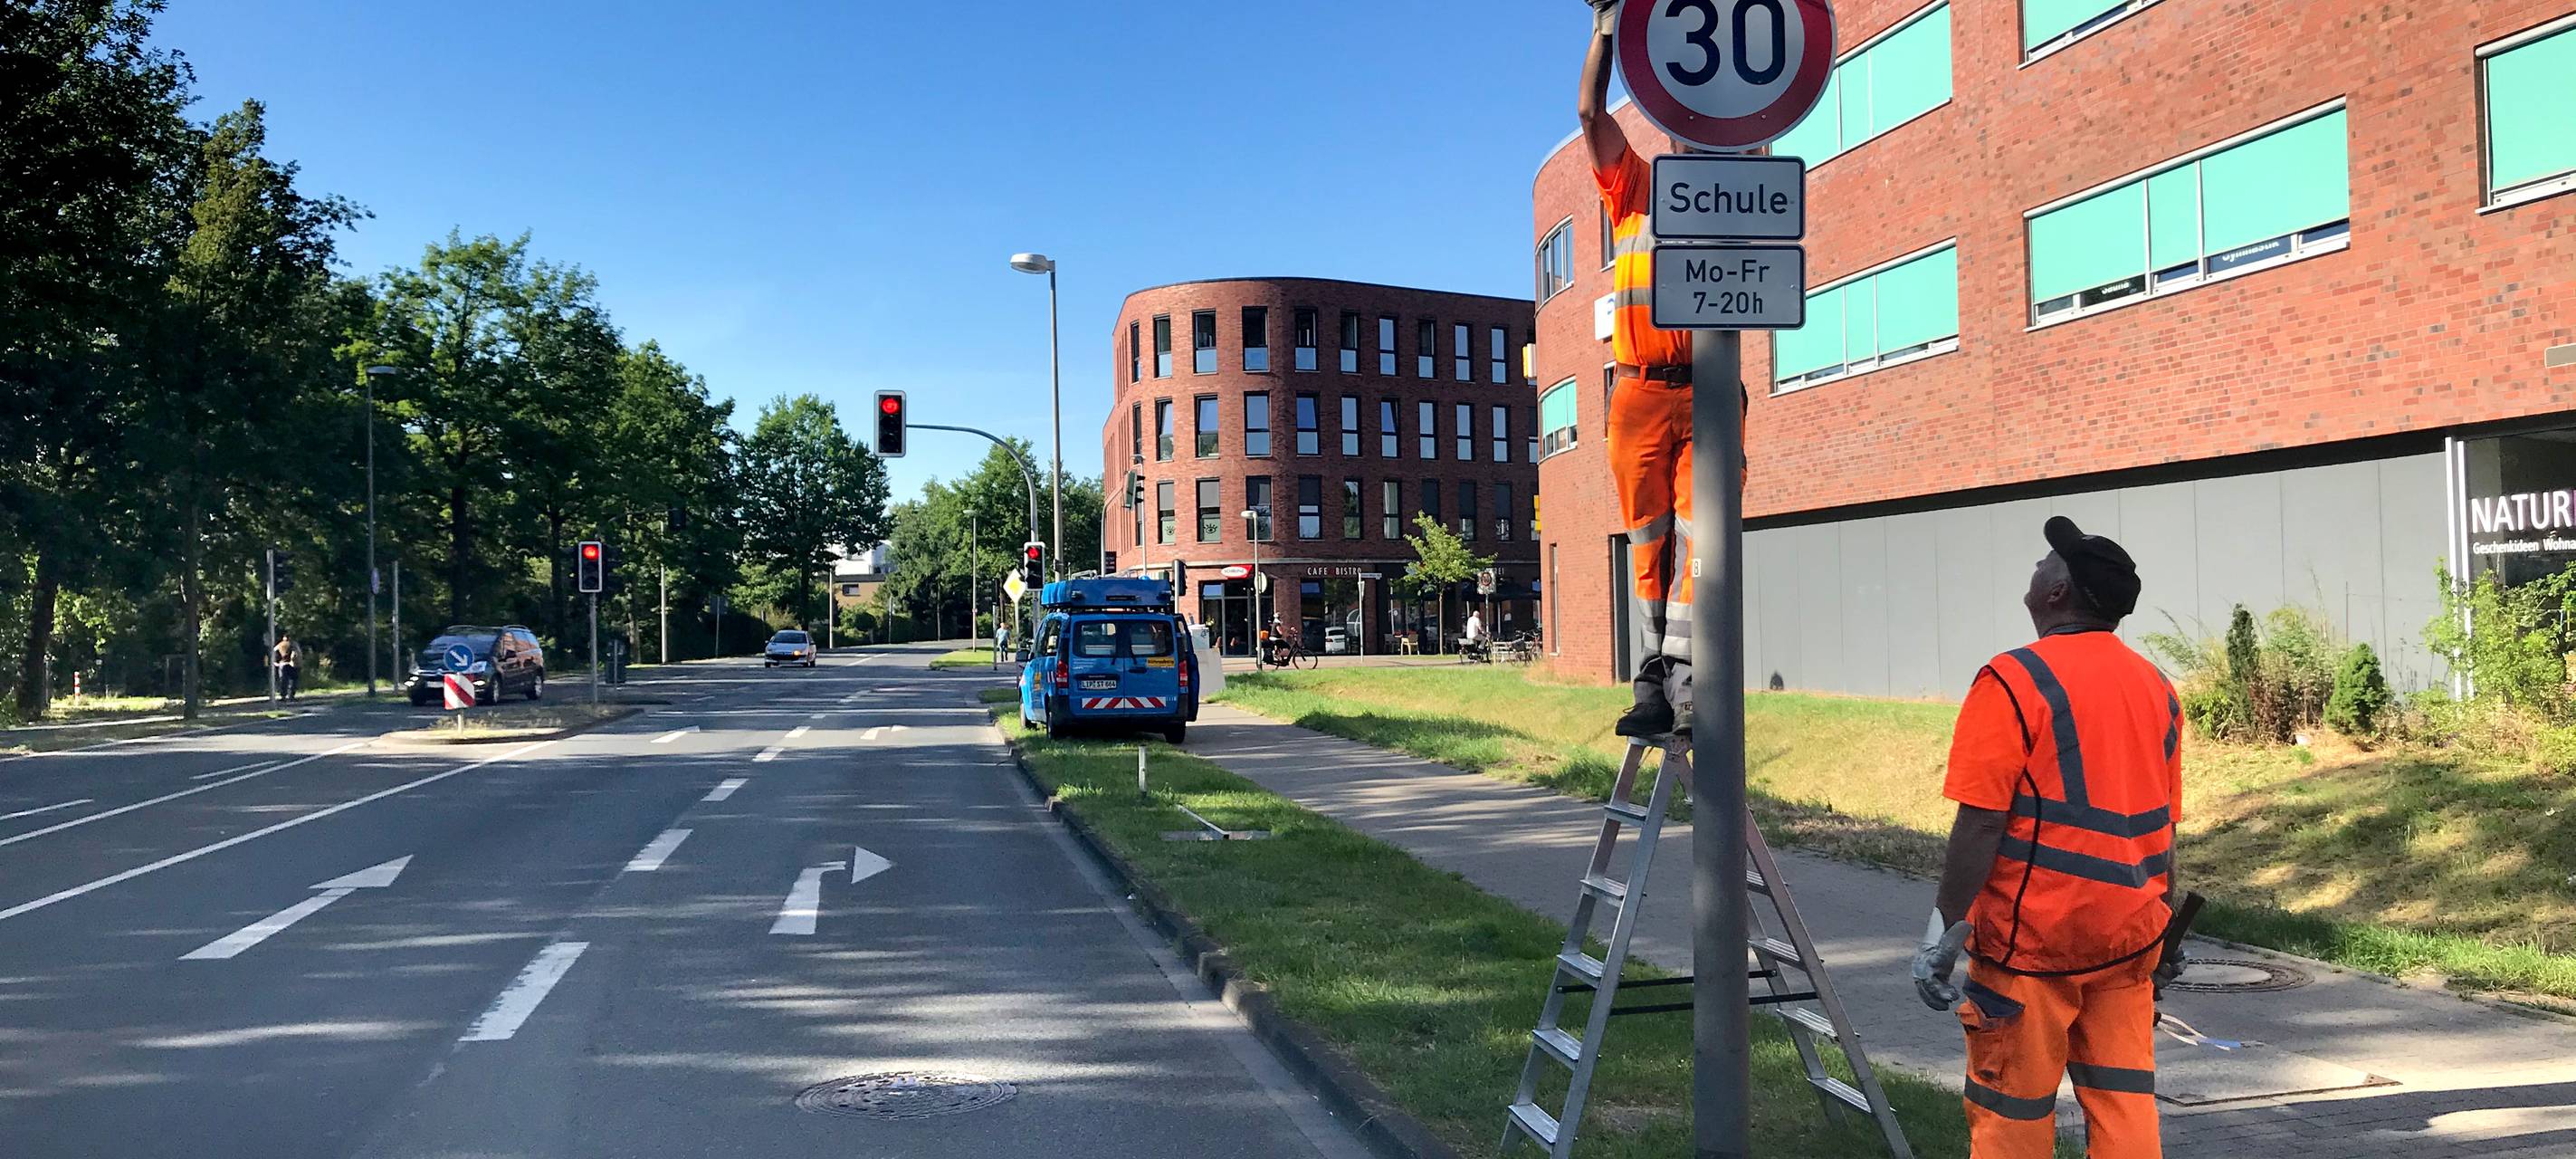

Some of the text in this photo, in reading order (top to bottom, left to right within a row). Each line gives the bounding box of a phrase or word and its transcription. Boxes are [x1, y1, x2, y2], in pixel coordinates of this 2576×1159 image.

[1665, 0, 1786, 86] 30
[1669, 182, 1789, 215] Schule
[1686, 259, 1770, 283] Mo-Fr
[1693, 292, 1763, 314] 7-20h
[2471, 489, 2576, 533] NATUR
[2473, 539, 2540, 554] Geschenkideen
[1307, 567, 1328, 576] CAFE
[1335, 567, 1362, 576] BISTRO
